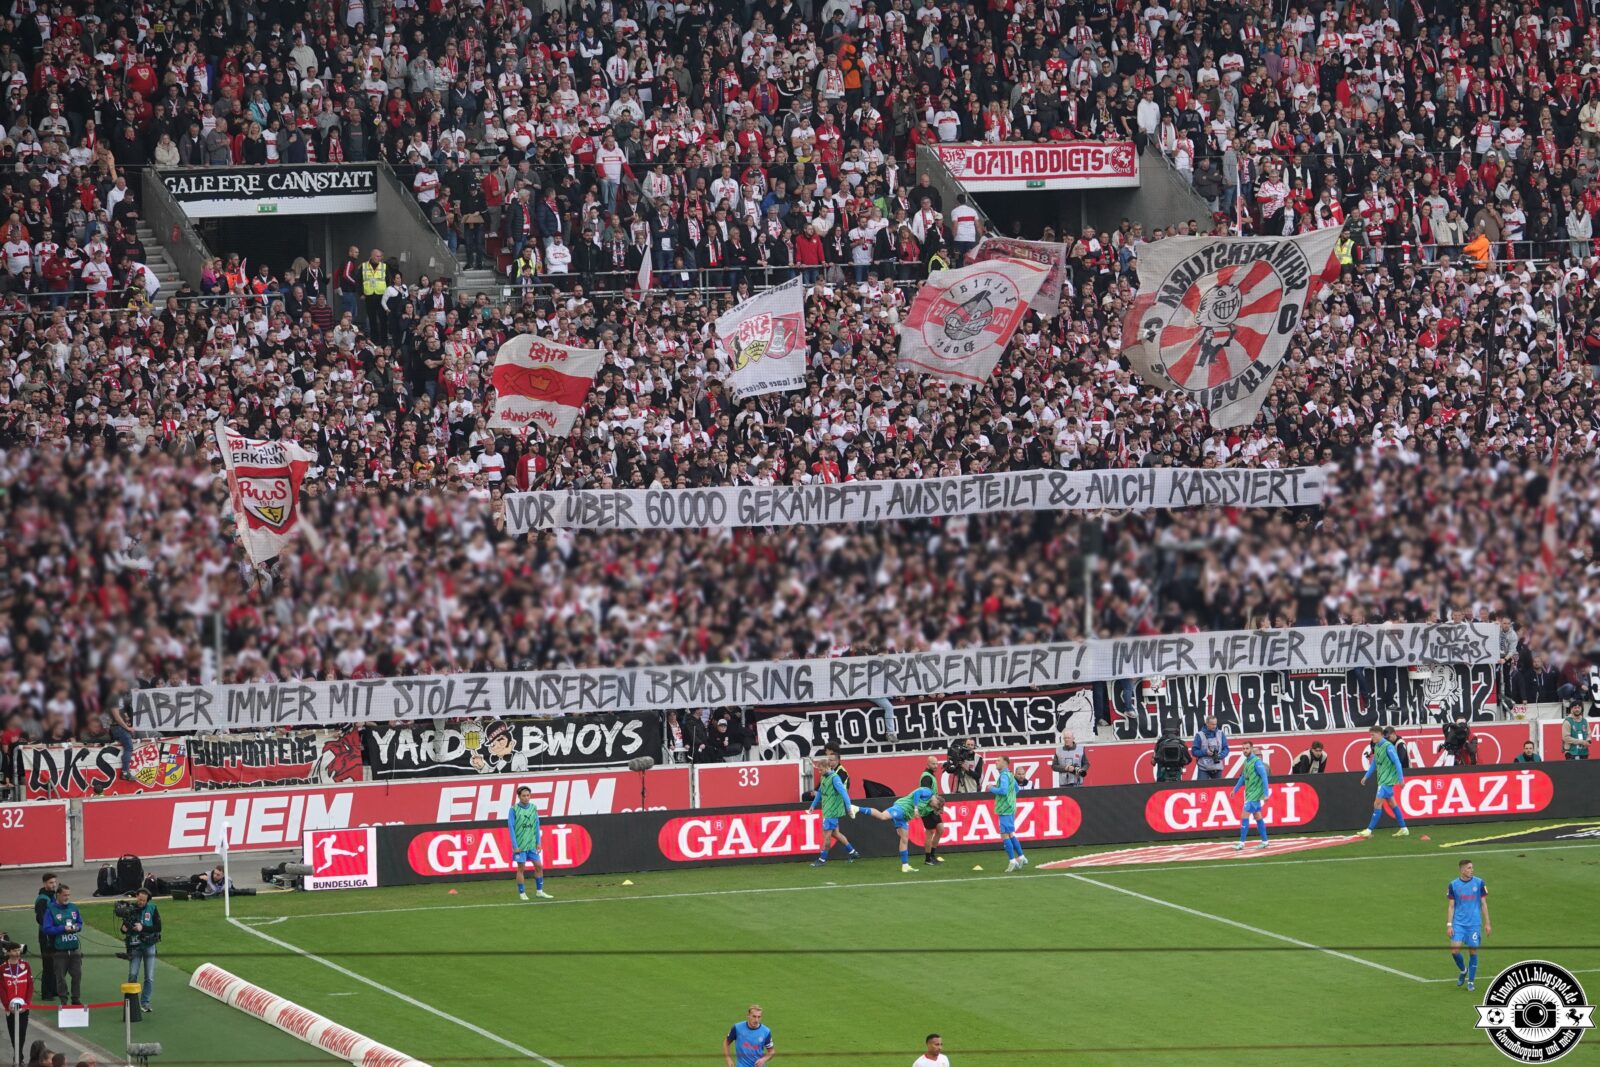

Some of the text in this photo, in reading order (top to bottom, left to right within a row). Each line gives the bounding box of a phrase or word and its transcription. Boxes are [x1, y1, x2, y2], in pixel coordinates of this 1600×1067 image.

[1021, 148, 1104, 174] ADDICTS
[164, 170, 374, 195] GALEERE CANNSTATT
[507, 495, 556, 528] VOR
[565, 489, 638, 527] ÜBER
[737, 484, 884, 524] GEKÄMPFT,
[886, 472, 1039, 516] AUSGETEILT
[1085, 468, 1156, 505] AUCH
[1429, 641, 1482, 661] ULTRAS
[132, 626, 1421, 729] ABER IMMER MIT STOLZ UNSEREN BRUSTRING REPRÄSENTIERT! IMMER WEITER CHRIS!
[808, 696, 1056, 747] HOOLIGANS
[373, 727, 464, 766] YARD
[522, 719, 644, 757] BWOYS
[738, 767, 760, 788] 33
[436, 777, 617, 823] EHEIM
[2, 808, 25, 829] 32
[168, 792, 354, 849] EHEIM
[312, 879, 369, 889] BUNDESLIGA
